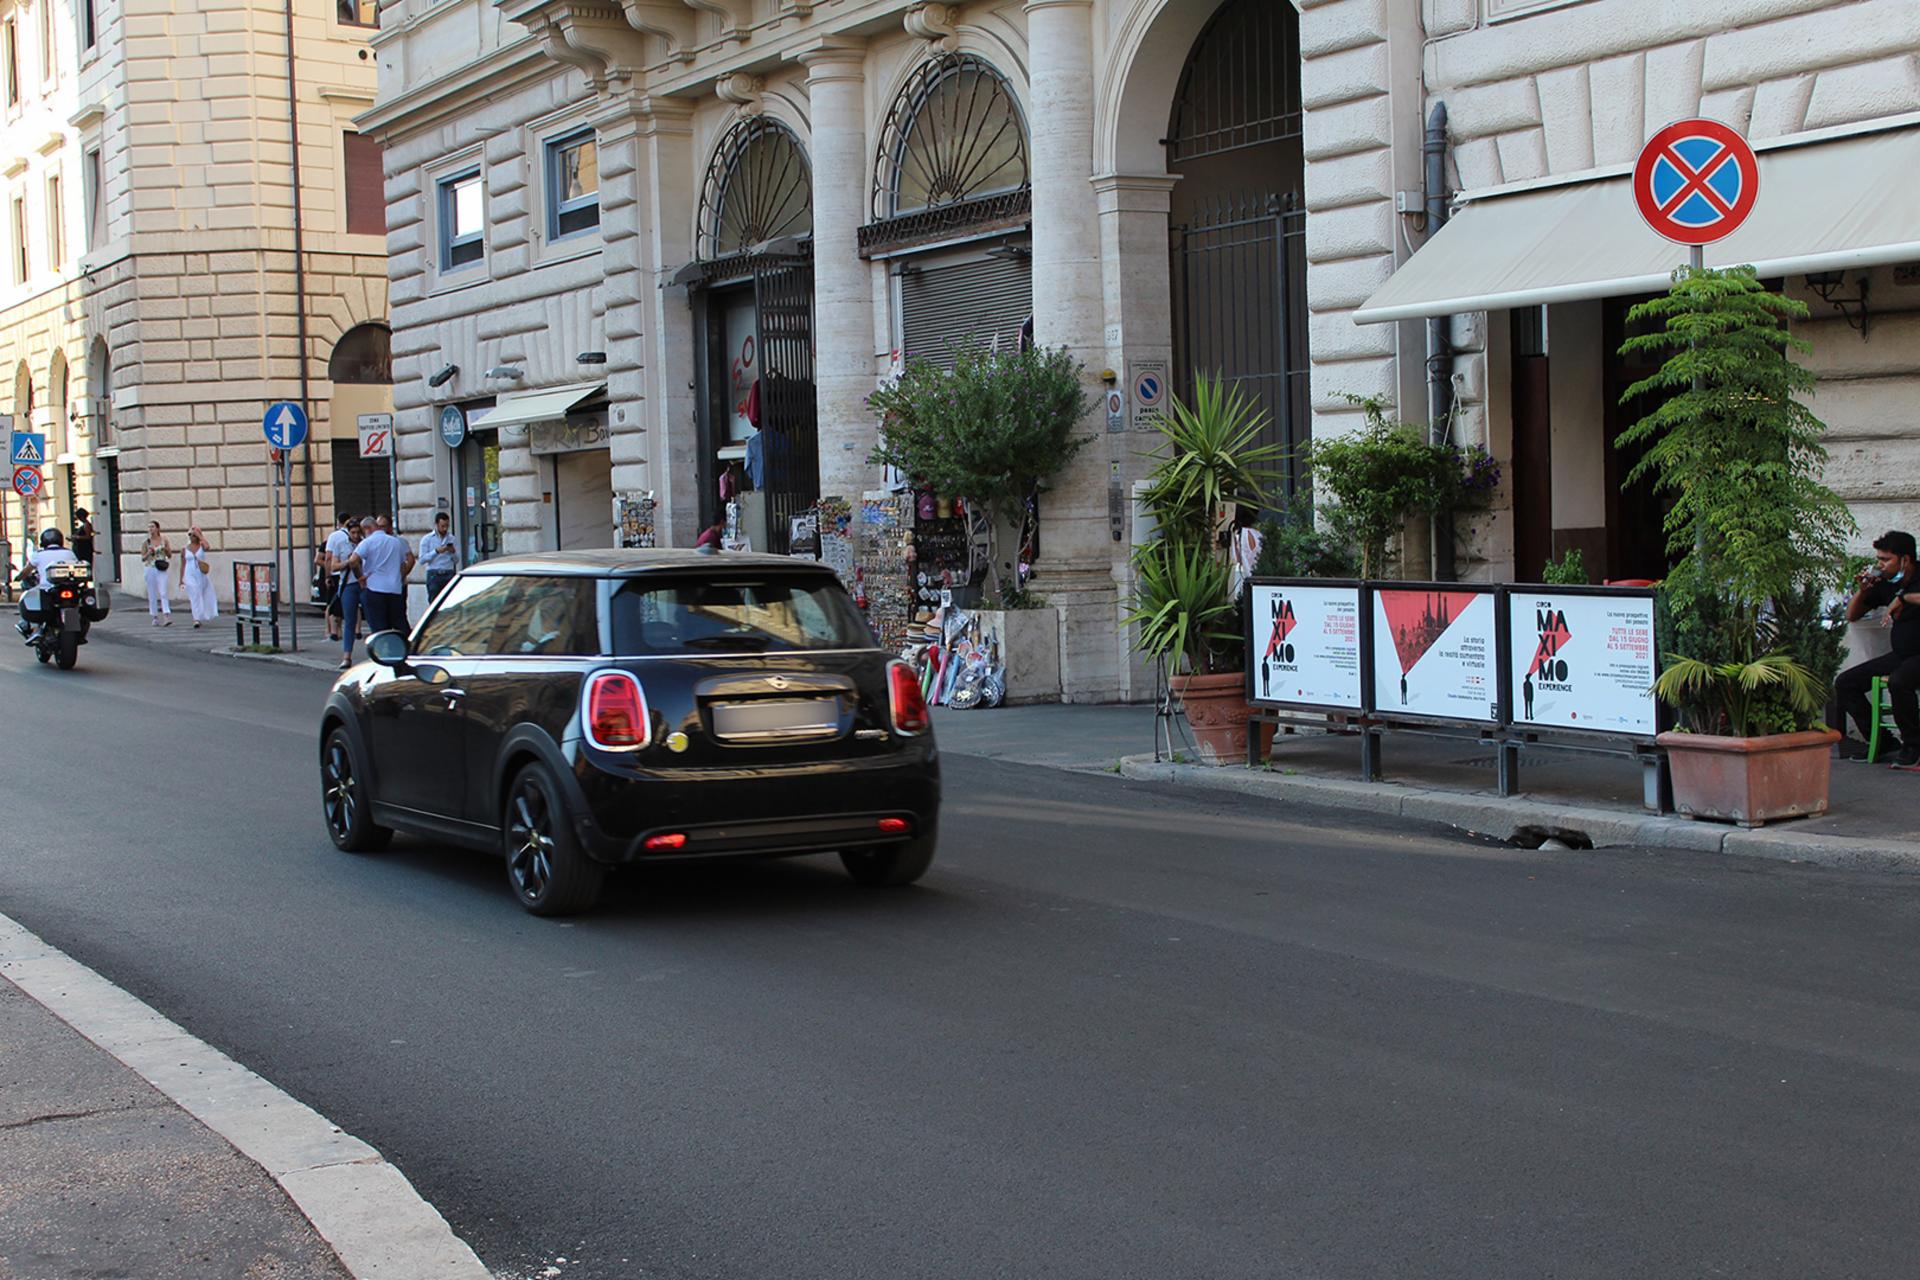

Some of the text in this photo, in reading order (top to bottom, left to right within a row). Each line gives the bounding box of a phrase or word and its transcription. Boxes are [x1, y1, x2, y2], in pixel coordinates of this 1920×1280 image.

[1271, 600, 1295, 619] MA
[1537, 609, 1568, 632] MA
[1272, 621, 1286, 641] XI
[1272, 643, 1295, 663] MO
[1538, 633, 1556, 656] XI
[1538, 659, 1568, 682] MO
[1538, 682, 1572, 692] EXPERIENCE
